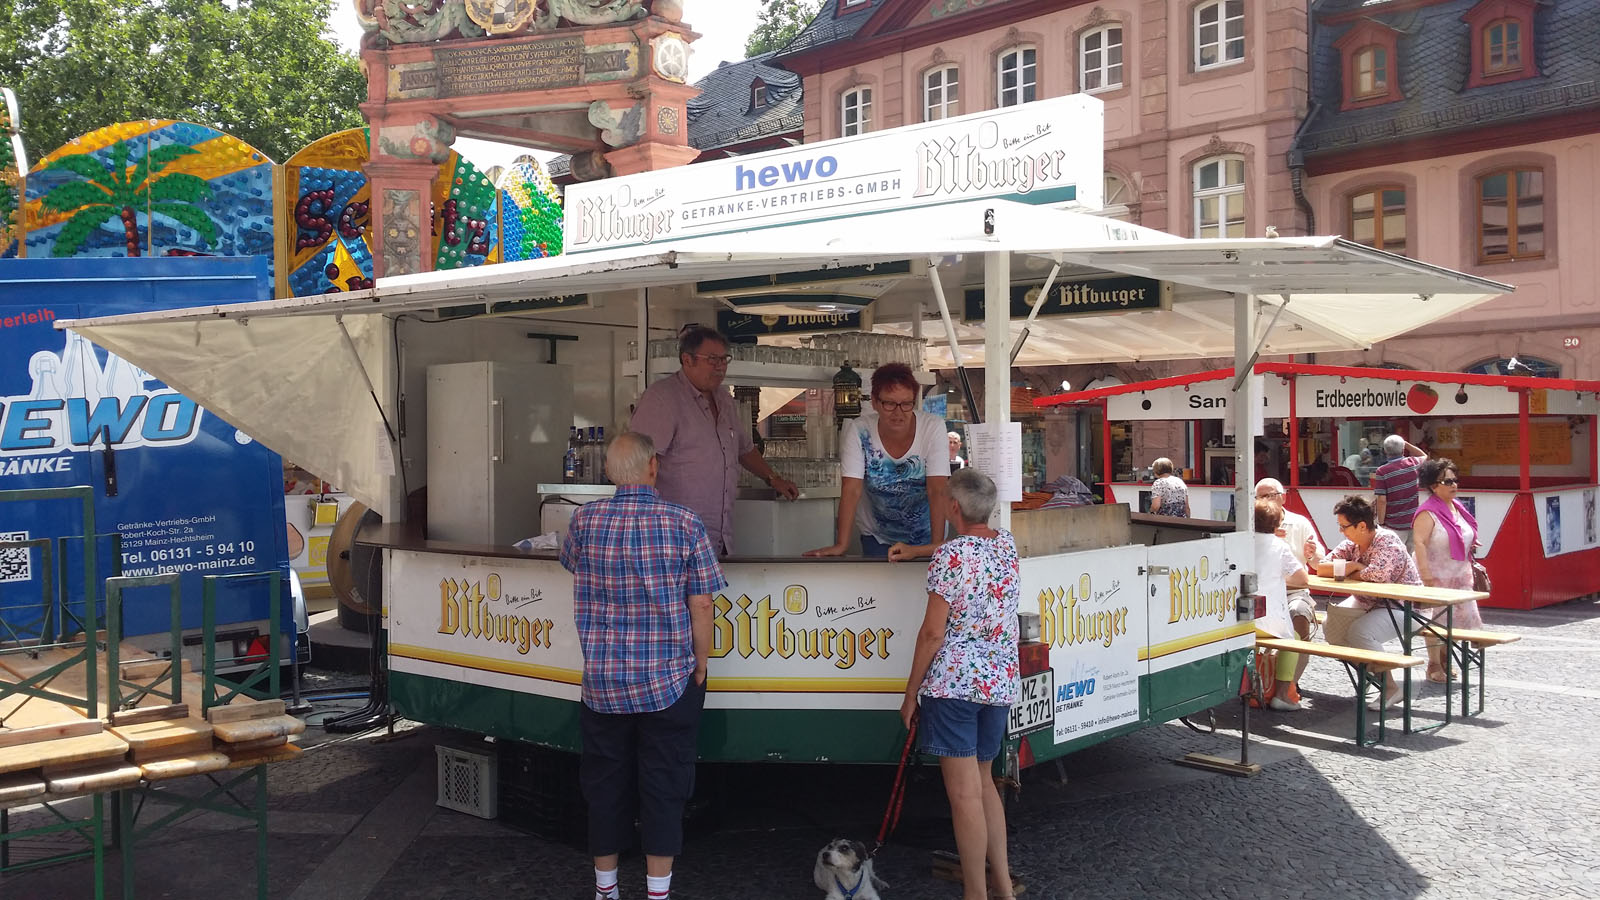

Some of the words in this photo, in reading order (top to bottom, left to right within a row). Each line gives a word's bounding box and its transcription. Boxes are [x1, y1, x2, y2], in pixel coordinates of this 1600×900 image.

[1036, 123, 1051, 135] Bit
[735, 155, 838, 191] hewo
[912, 134, 1066, 198] Bitburger
[682, 178, 901, 220] GETRÄNKE-VERTRIEBS-GMBH
[573, 194, 675, 246] Bitburger
[1059, 283, 1146, 306] Bitburger
[1564, 337, 1579, 347] 20
[0, 393, 197, 450] EWO
[0, 456, 74, 476] ÄNKE
[117, 515, 216, 531] Getränke-Vertriebs-GmbH
[183, 526, 194, 534] 2a
[121, 551, 147, 564] Tel.
[150, 547, 191, 562] 06131
[205, 545, 214, 556] 5
[217, 542, 235, 555] 94
[238, 540, 255, 552] 10
[144, 534, 215, 547] Mainz-Hechtsheim
[121, 555, 256, 577] www.hewo-mainz.de
[1168, 566, 1238, 624] Bitburger
[437, 577, 554, 655] Bitburger
[815, 605, 838, 618] Bitte
[841, 604, 856, 612] ein
[857, 597, 876, 608] Bit
[1037, 584, 1128, 650] Bitburger
[707, 594, 894, 669] Bitburger
[1022, 678, 1037, 702] MZ
[1056, 678, 1095, 702] HEWO
[1010, 706, 1024, 729] HE
[1026, 698, 1051, 724] 1971
